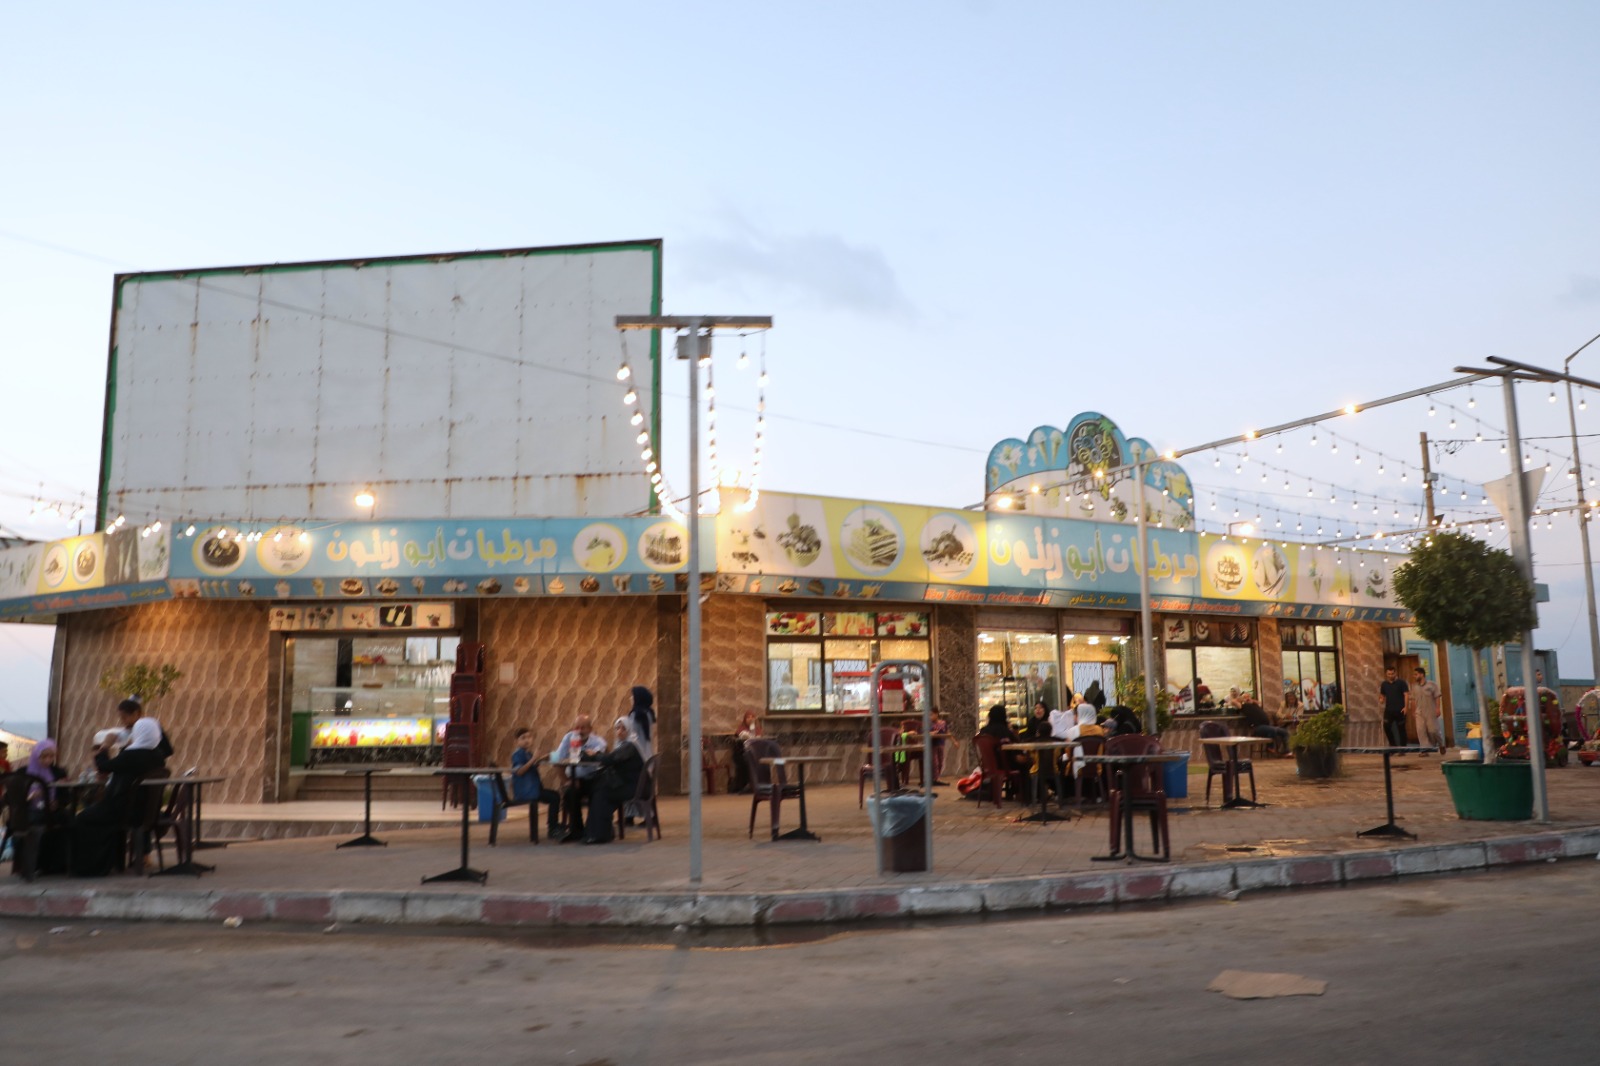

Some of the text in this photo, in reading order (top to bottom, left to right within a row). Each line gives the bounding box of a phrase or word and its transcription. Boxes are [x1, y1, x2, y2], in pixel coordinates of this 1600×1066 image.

[326, 526, 557, 570] مرطبات أبو زيتون
[989, 524, 1199, 584] مرطات أبو زيتون
